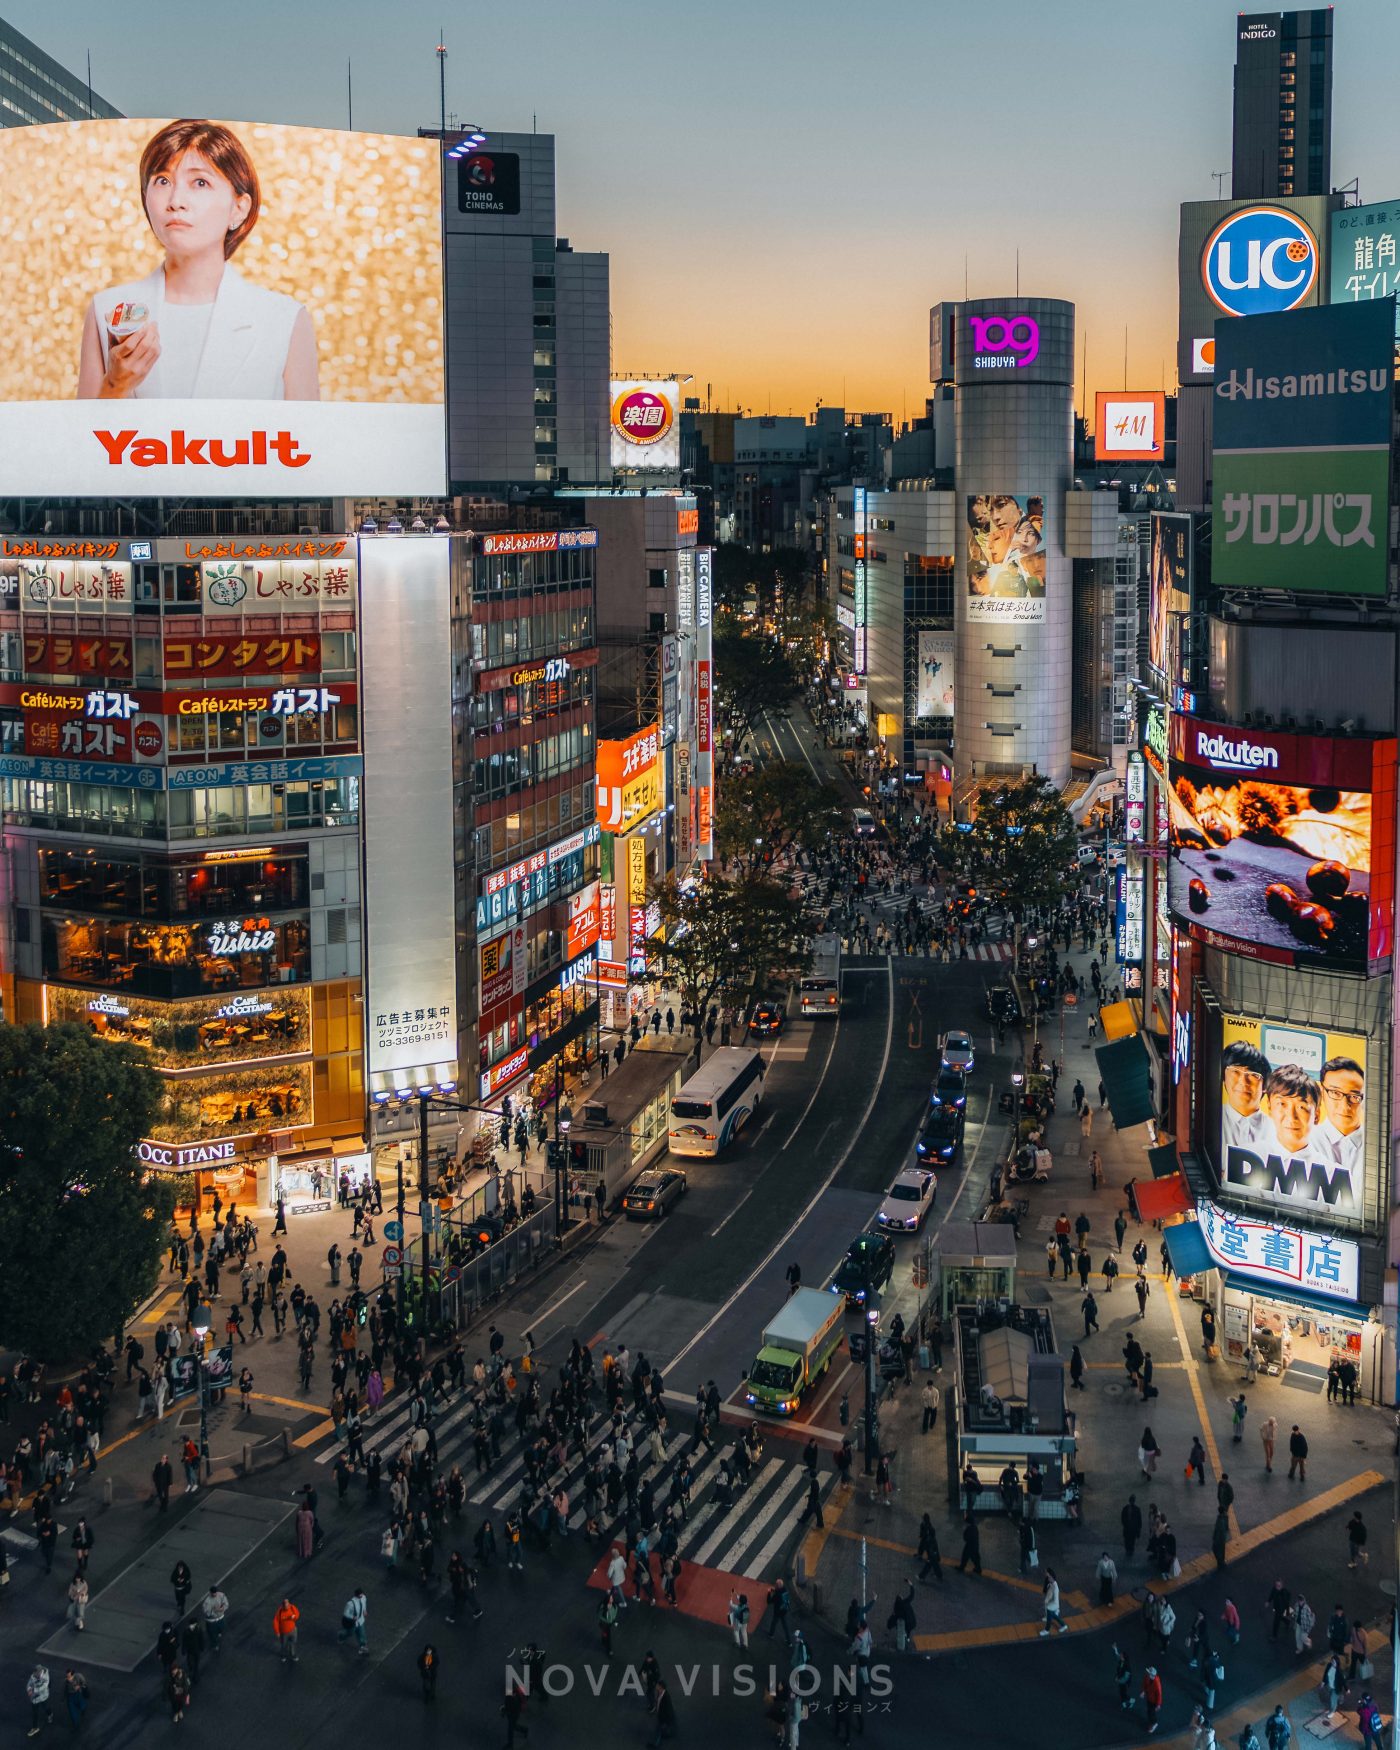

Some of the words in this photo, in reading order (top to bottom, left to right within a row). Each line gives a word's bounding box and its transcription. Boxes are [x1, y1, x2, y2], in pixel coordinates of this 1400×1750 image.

[1240, 29, 1276, 40] INDIGO
[465, 192, 493, 201] TOHO
[465, 201, 504, 210] CINEMAS
[968, 315, 1040, 367] 109
[975, 356, 1016, 368] SHIBUYA
[1216, 368, 1387, 401] Hisamitsu
[622, 405, 665, 426] 楽園
[1114, 415, 1147, 437] H&M
[615, 424, 638, 444] EXCITING
[639, 424, 671, 445] AMUSEMENT
[93, 430, 312, 468] Yakult
[1222, 492, 1376, 549] サロンパス
[2, 540, 120, 559] しゃぶしゃぶバイキング
[185, 540, 348, 559] しゃぶしゃぶバイキング
[699, 553, 709, 573] BIC
[59, 571, 126, 600] しゃぶ葉
[256, 566, 350, 598] しゃぶ葉
[699, 575, 710, 628] CAMERA
[26, 638, 132, 668] プライス
[166, 638, 319, 670] コンタクト
[545, 657, 570, 682] ガスト
[87, 690, 140, 719] ガスト
[272, 688, 341, 716] ガスト
[1, 720, 25, 741] 7F
[31, 722, 59, 739] Café
[262, 725, 280, 733] ガスト
[699, 696, 709, 743] TaxFree
[61, 720, 126, 755] ガスト
[138, 736, 160, 747] ガスト
[1197, 731, 1279, 768] Rakuten
[0, 759, 30, 773] AEON
[40, 760, 133, 783] 英会話イーオン
[175, 768, 219, 784] AEON
[587, 823, 600, 844] 4F
[476, 884, 517, 927] AGA
[574, 909, 595, 936] アコム
[208, 930, 276, 955] Ushi8
[581, 934, 588, 948] 3F
[1211, 934, 1236, 948] Rakuten
[1236, 941, 1257, 954] Vision
[484, 946, 497, 977] 薬
[562, 952, 592, 990] LUSH
[482, 977, 512, 1006] サンドラッグ
[376, 1005, 450, 1027] 広告主募集中
[1227, 1018, 1247, 1028] DMM
[1248, 1021, 1258, 1029] TV
[379, 1020, 449, 1038] ツツミプロジェクト
[379, 1031, 449, 1048] 03-3369-8151
[501, 1050, 528, 1077] サンドラッグ
[1226, 1144, 1354, 1206] DMM
[1306, 1278, 1324, 1289] BOOKS
[1325, 1281, 1350, 1294] TAISEIDO
